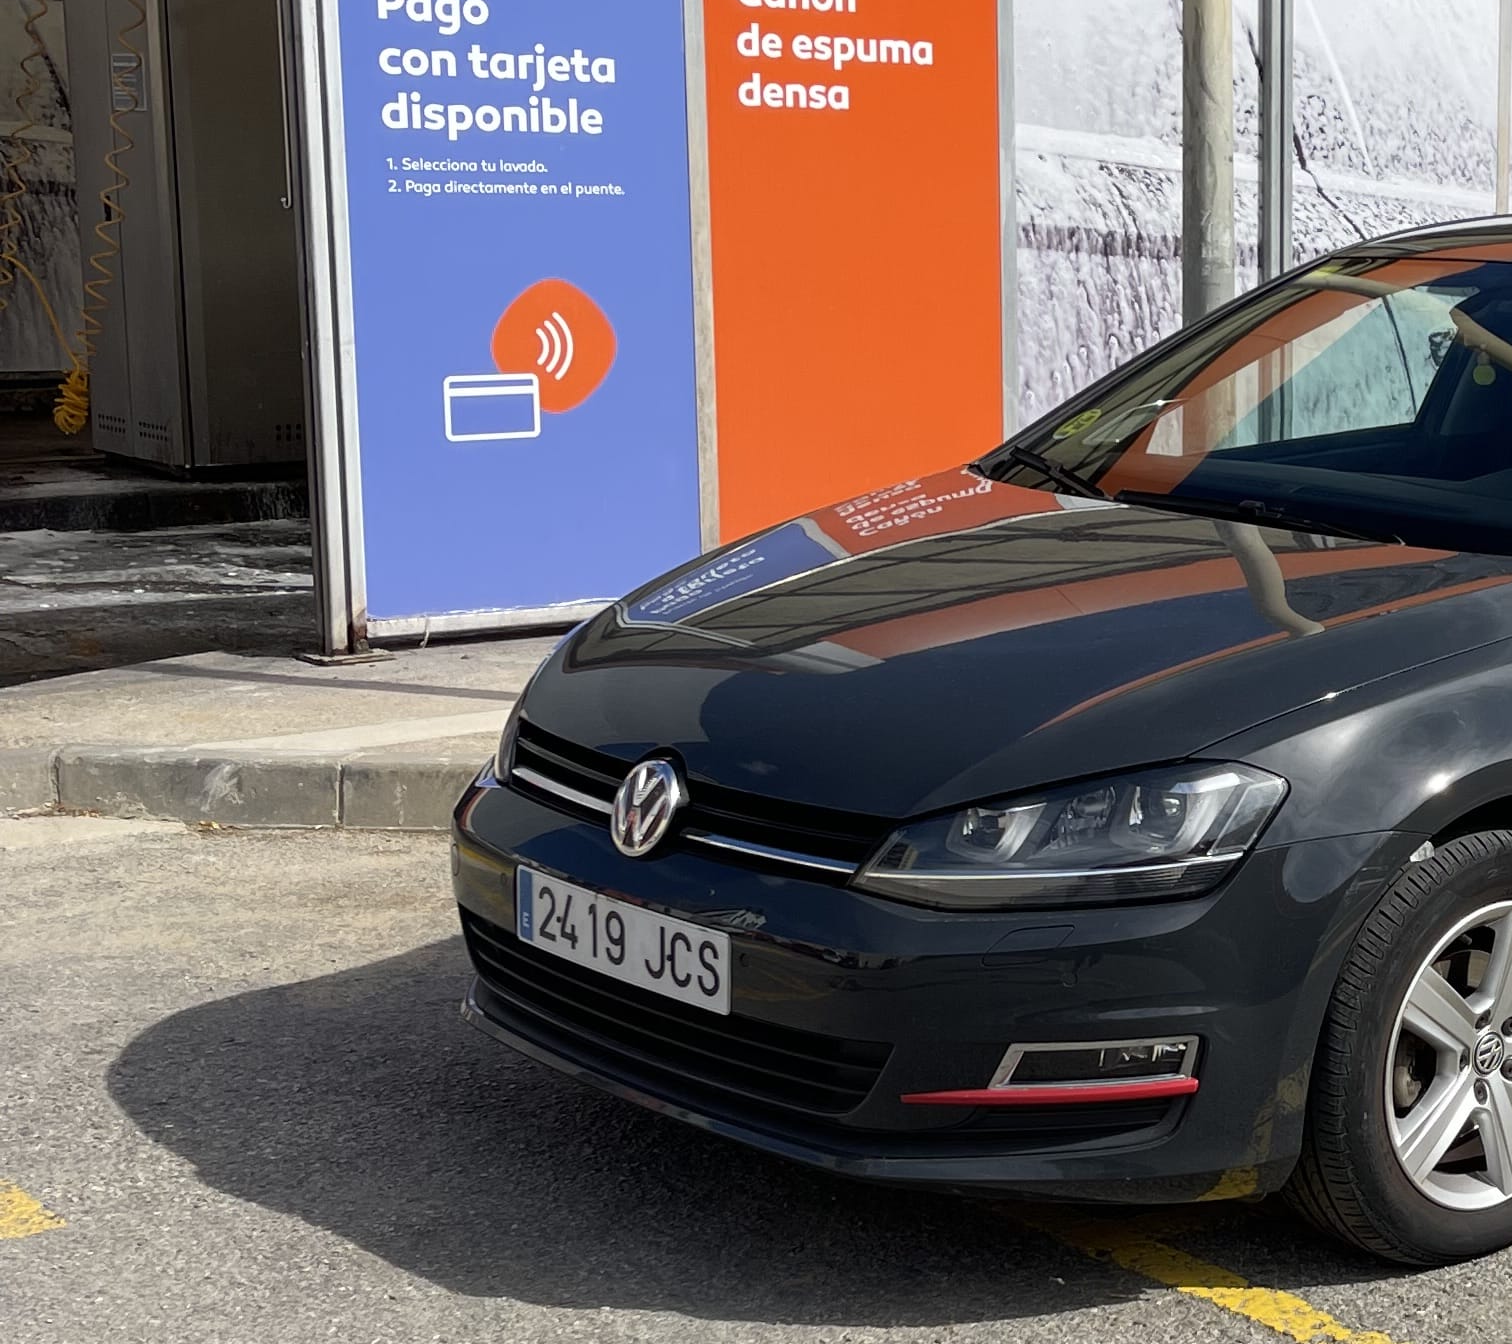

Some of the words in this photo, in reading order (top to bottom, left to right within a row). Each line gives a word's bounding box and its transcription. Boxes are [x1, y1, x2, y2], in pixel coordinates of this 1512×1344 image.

[379, 48, 456, 76] con
[468, 44, 615, 91] tarjeta
[737, 23, 782, 58] de
[792, 35, 933, 70] espuma
[738, 73, 849, 110] densa
[382, 92, 602, 140] disponible
[387, 158, 398, 170] 1.
[402, 158, 477, 171] Selecciona
[481, 160, 496, 171] tu
[500, 160, 548, 172] lavado.
[388, 180, 401, 192] 2.
[406, 180, 440, 196] Paga
[445, 180, 537, 194] directamente
[541, 185, 557, 194] en
[561, 182, 572, 194] el
[576, 184, 625, 197] puente.
[538, 886, 626, 965] 2419
[644, 925, 721, 997] JCS
